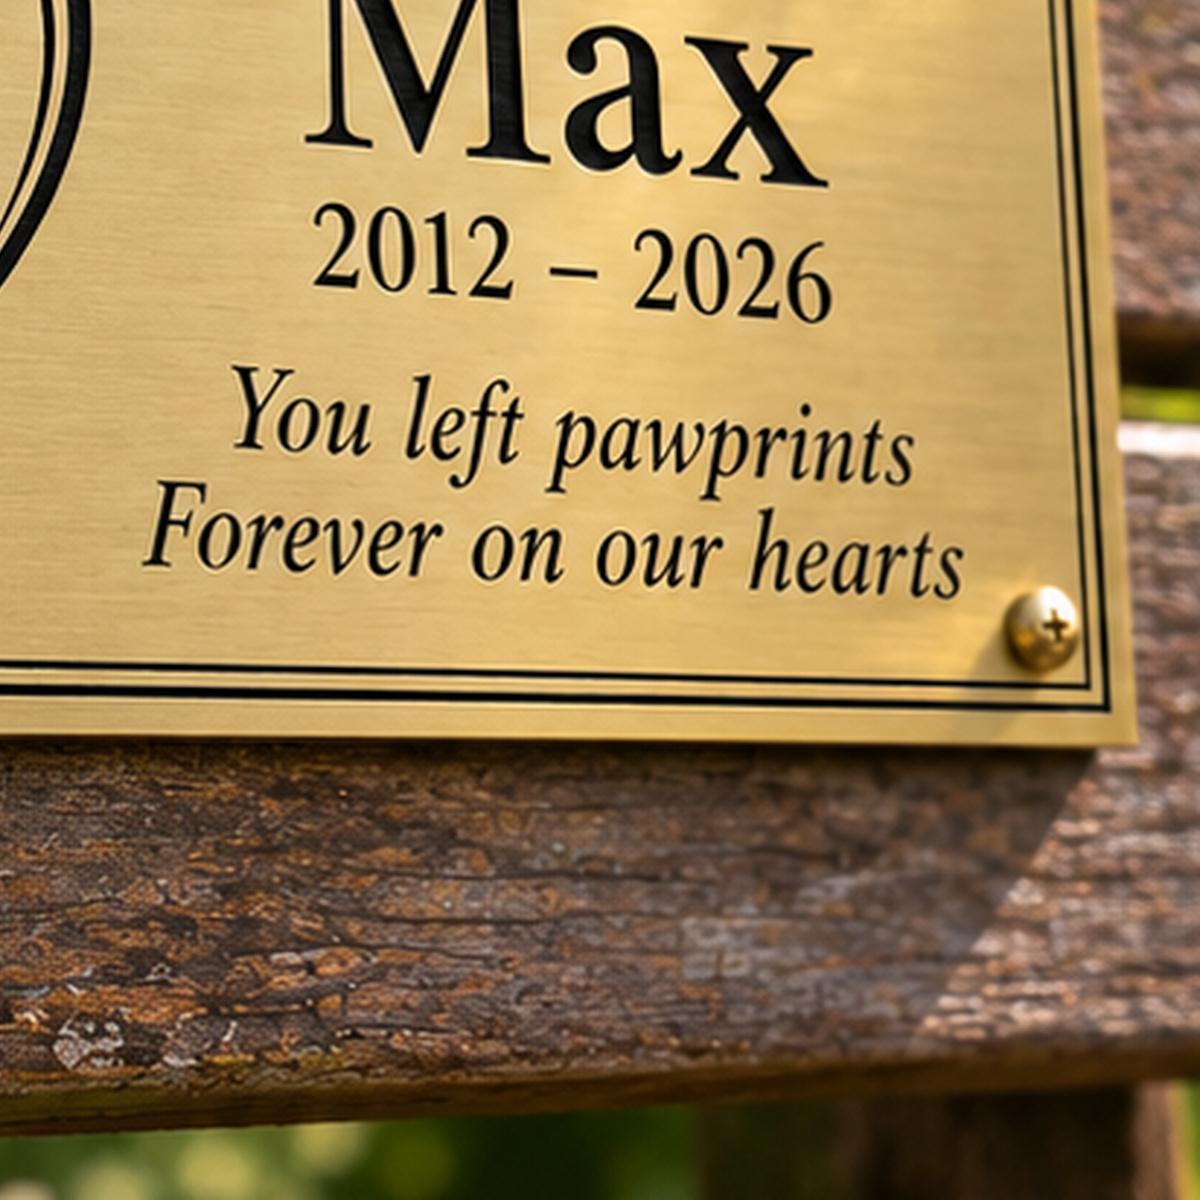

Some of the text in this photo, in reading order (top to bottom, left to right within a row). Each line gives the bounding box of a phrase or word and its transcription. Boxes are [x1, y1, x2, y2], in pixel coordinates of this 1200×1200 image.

[313, 201, 515, 301] 2012
[633, 228, 833, 325] 2026
[230, 364, 916, 503] You left pawprints
[141, 479, 966, 601] Forever on our hearts
